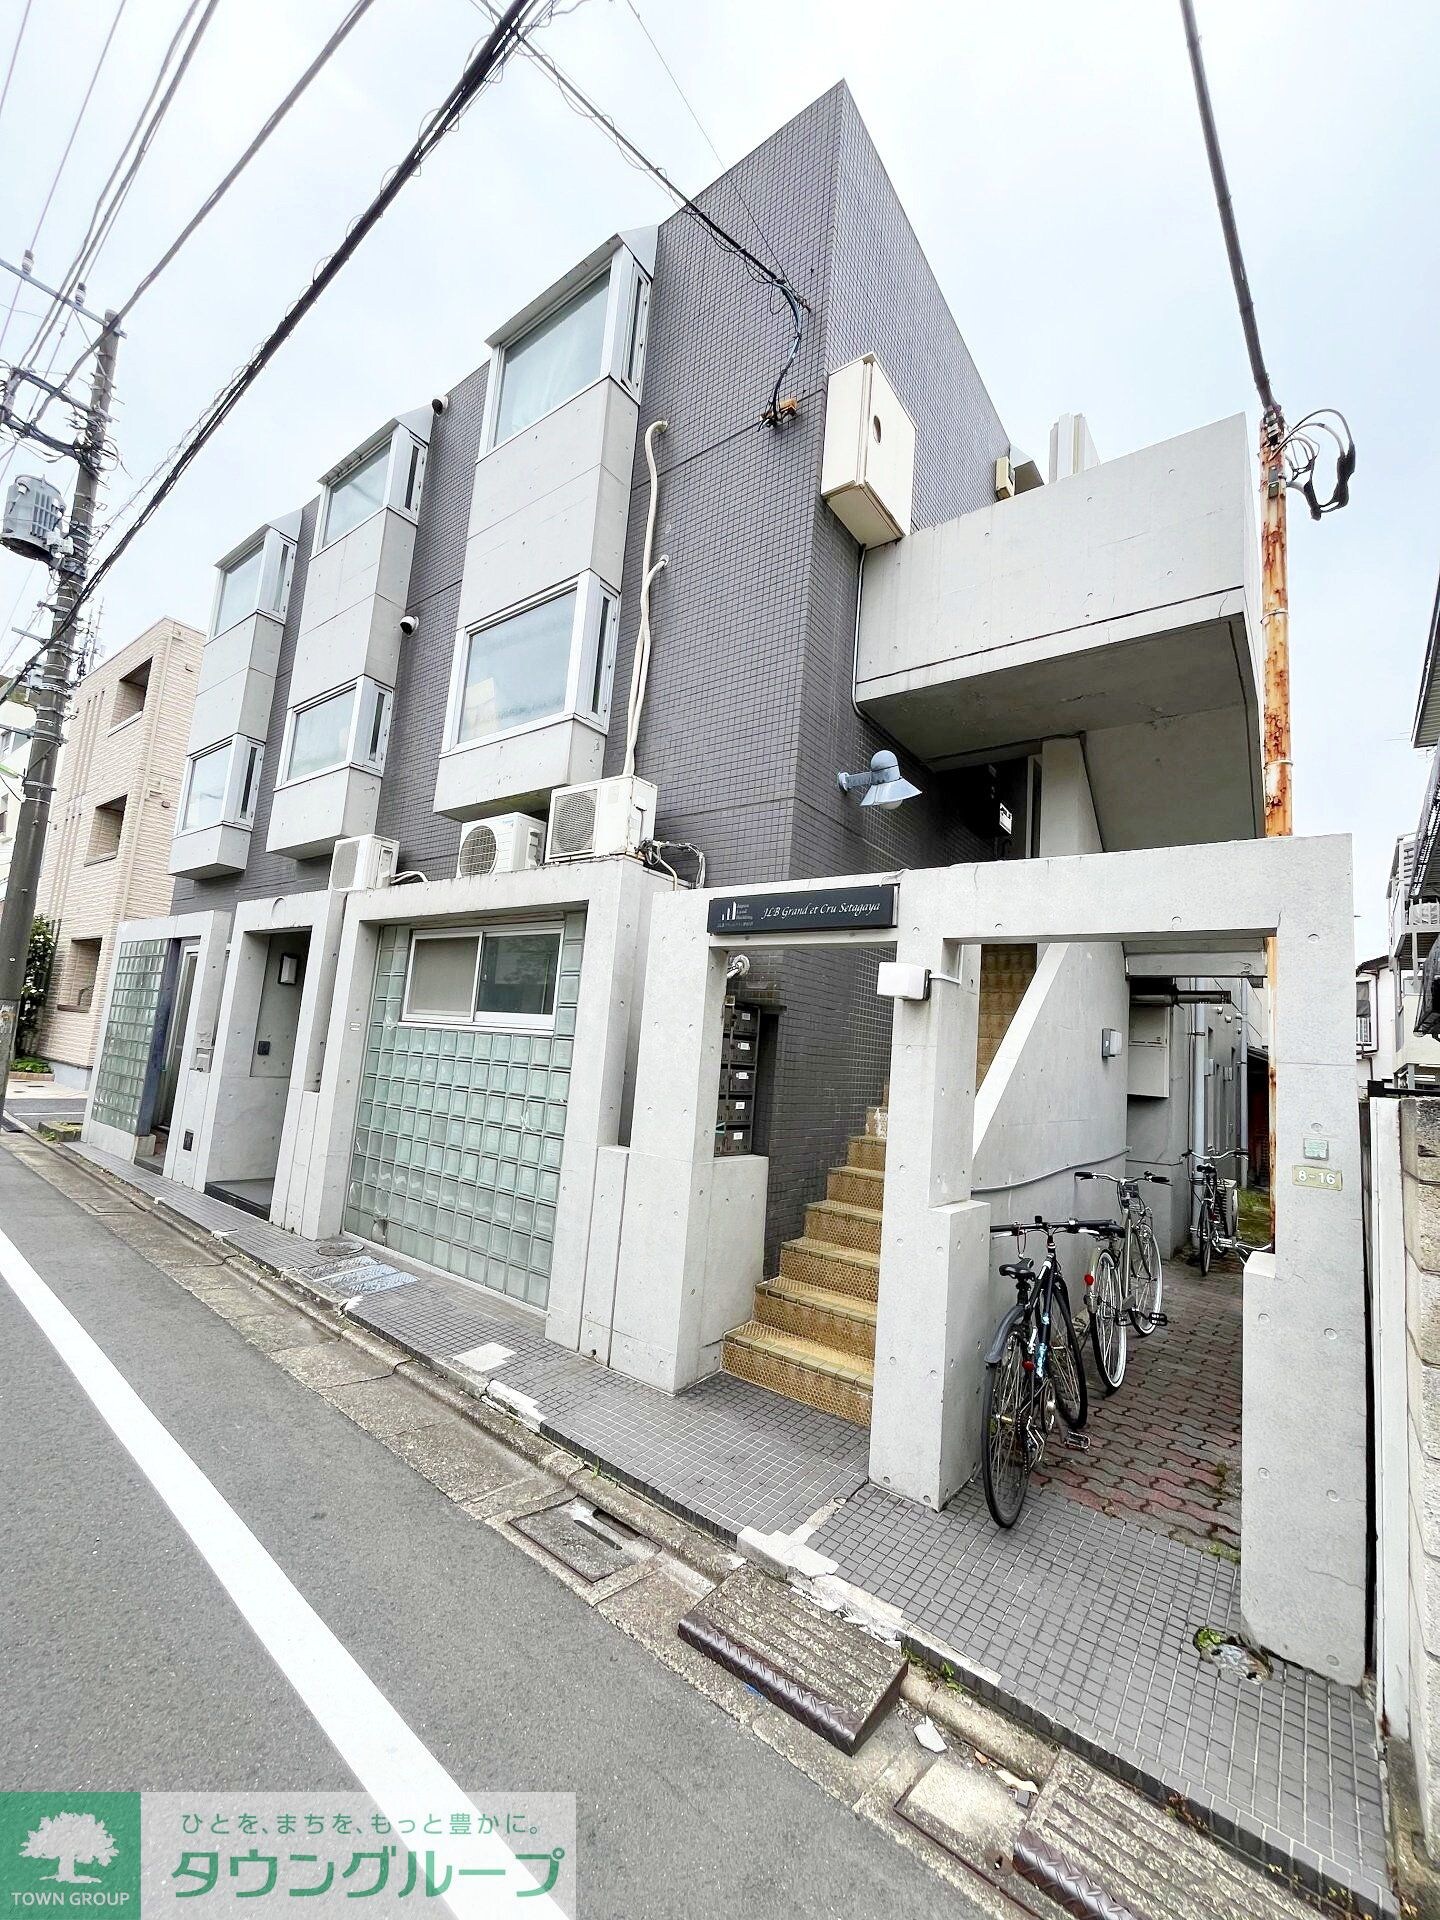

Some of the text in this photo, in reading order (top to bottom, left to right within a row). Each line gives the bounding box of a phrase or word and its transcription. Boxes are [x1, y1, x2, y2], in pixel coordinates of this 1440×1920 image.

[760, 902, 881, 920] JLB Grand et Cru Setagaya
[1298, 1170, 1336, 1185] 8-16
